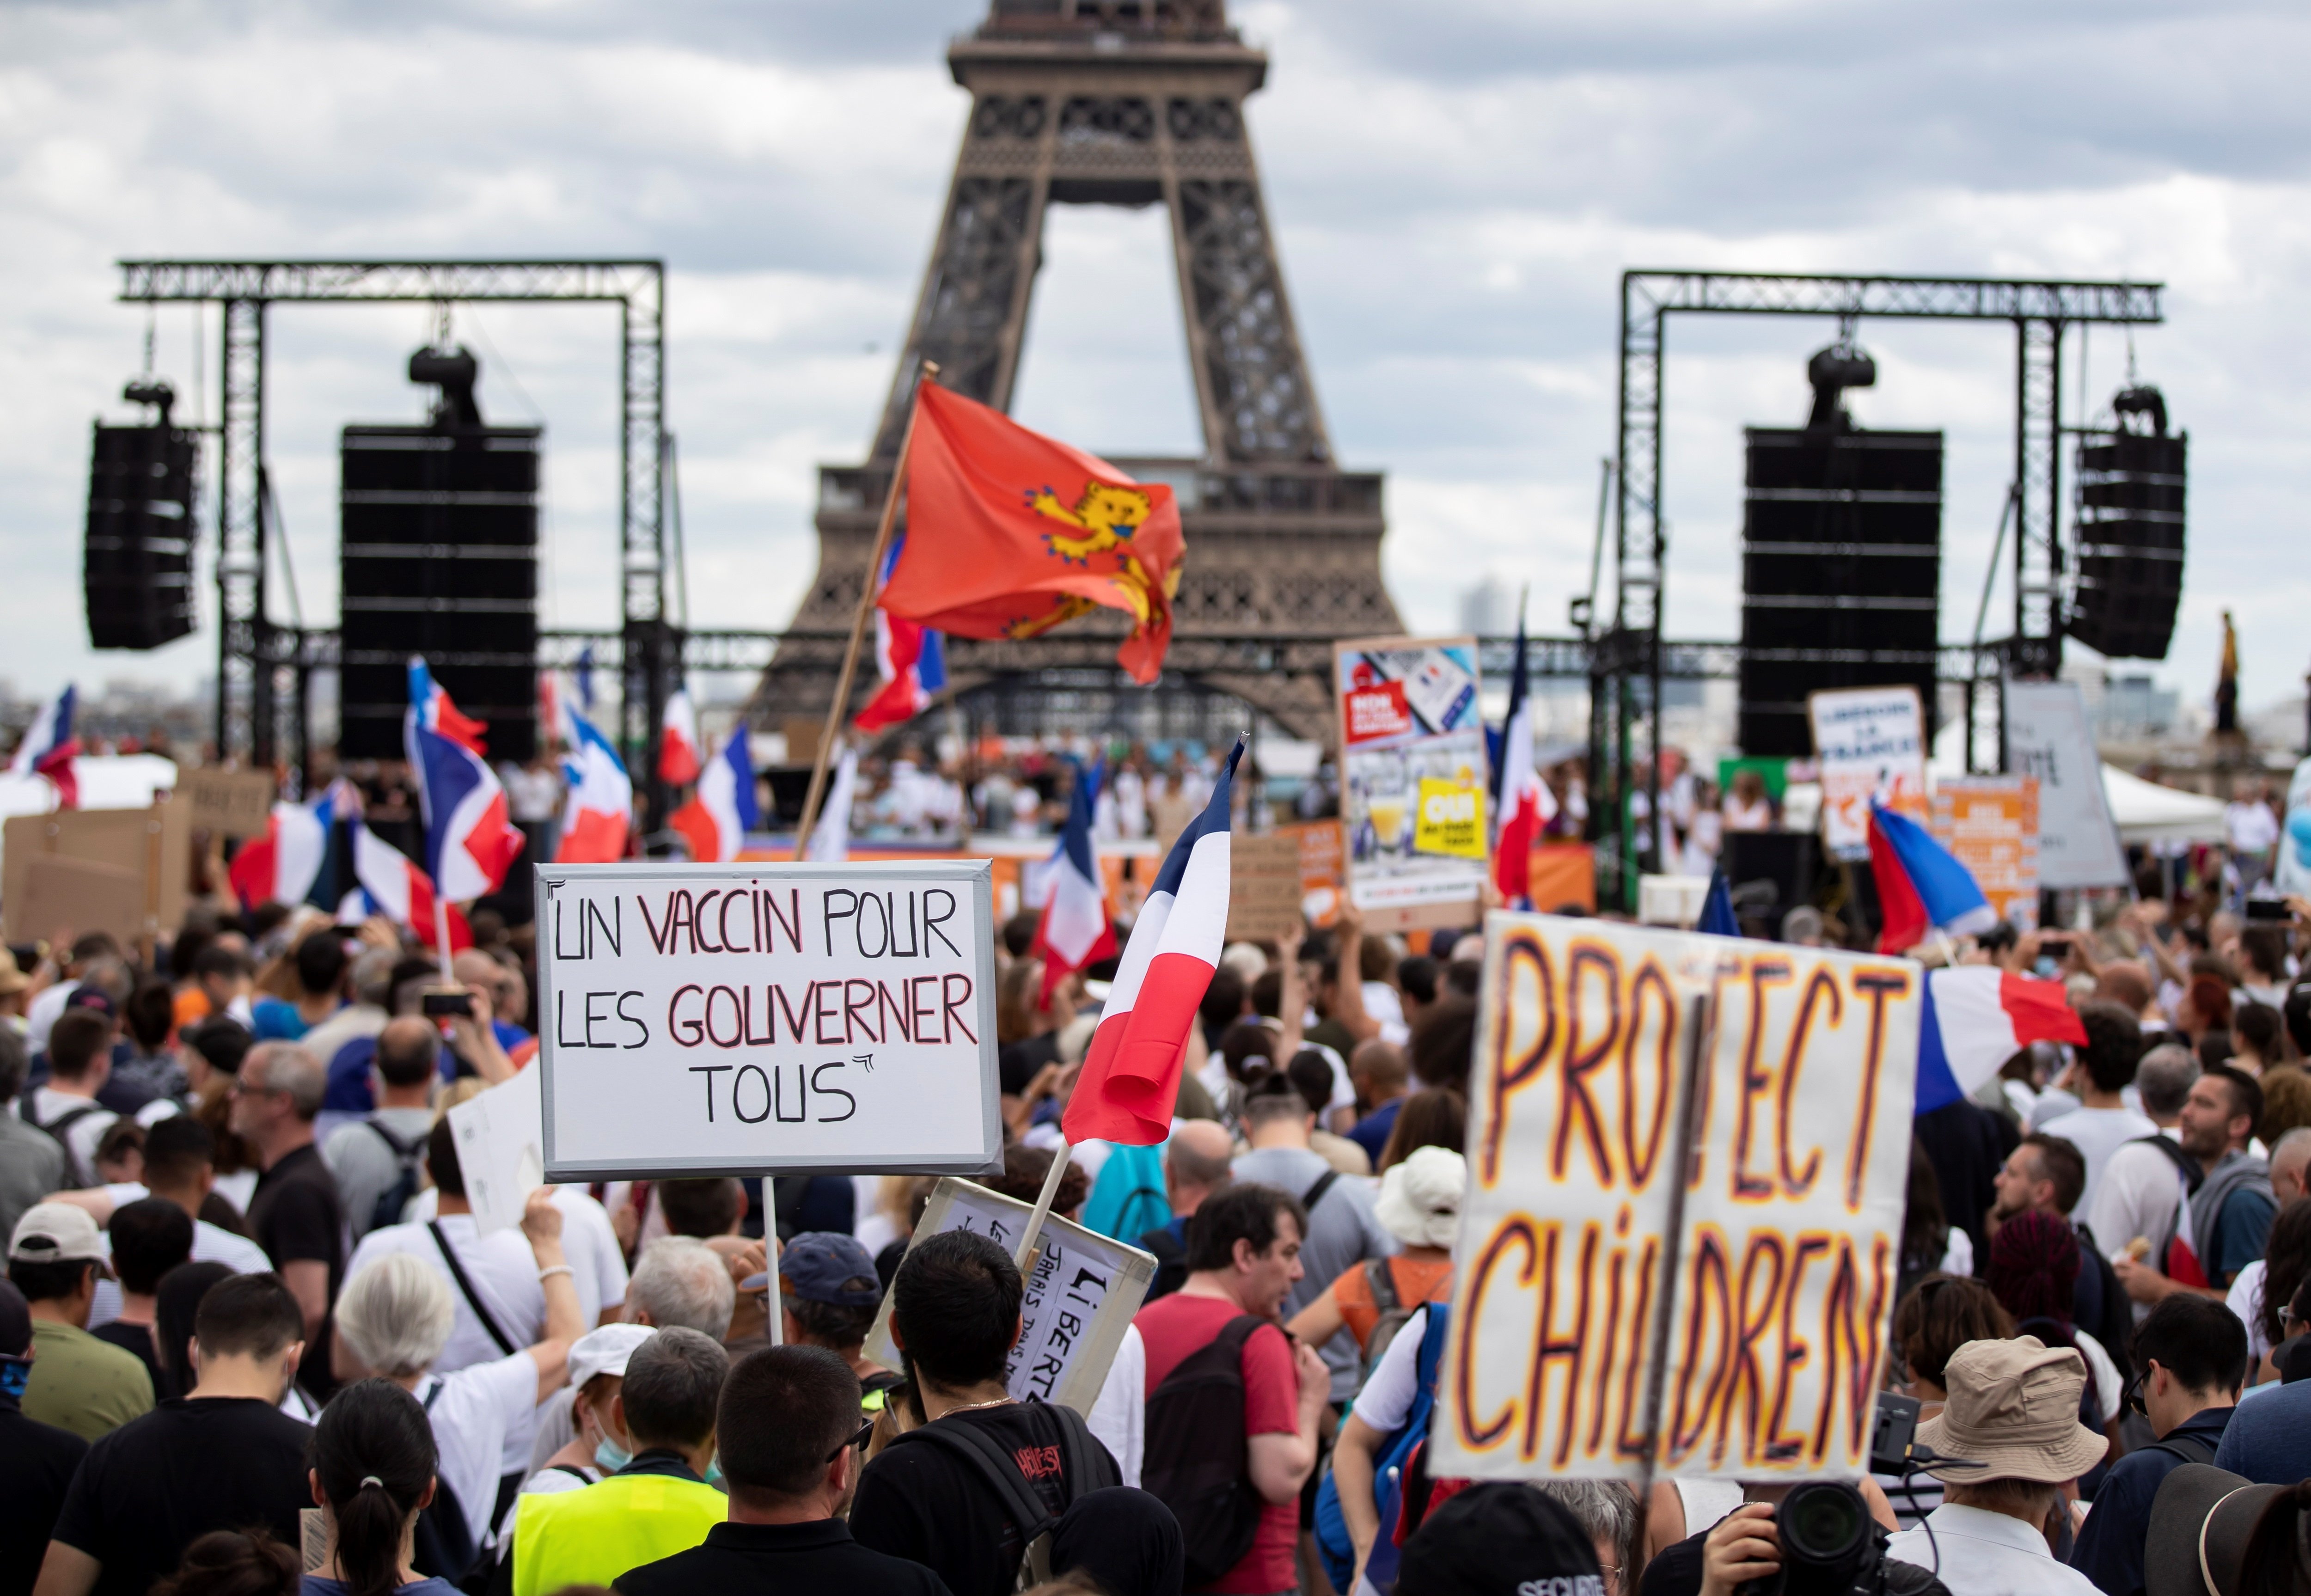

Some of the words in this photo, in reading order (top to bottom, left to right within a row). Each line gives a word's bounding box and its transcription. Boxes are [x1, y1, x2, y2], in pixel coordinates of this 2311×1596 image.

[1425, 793, 1475, 823] OUI
[823, 888, 962, 958] POUR
[558, 990, 650, 1049] LES
[668, 972, 979, 1049] GOUVERNER
